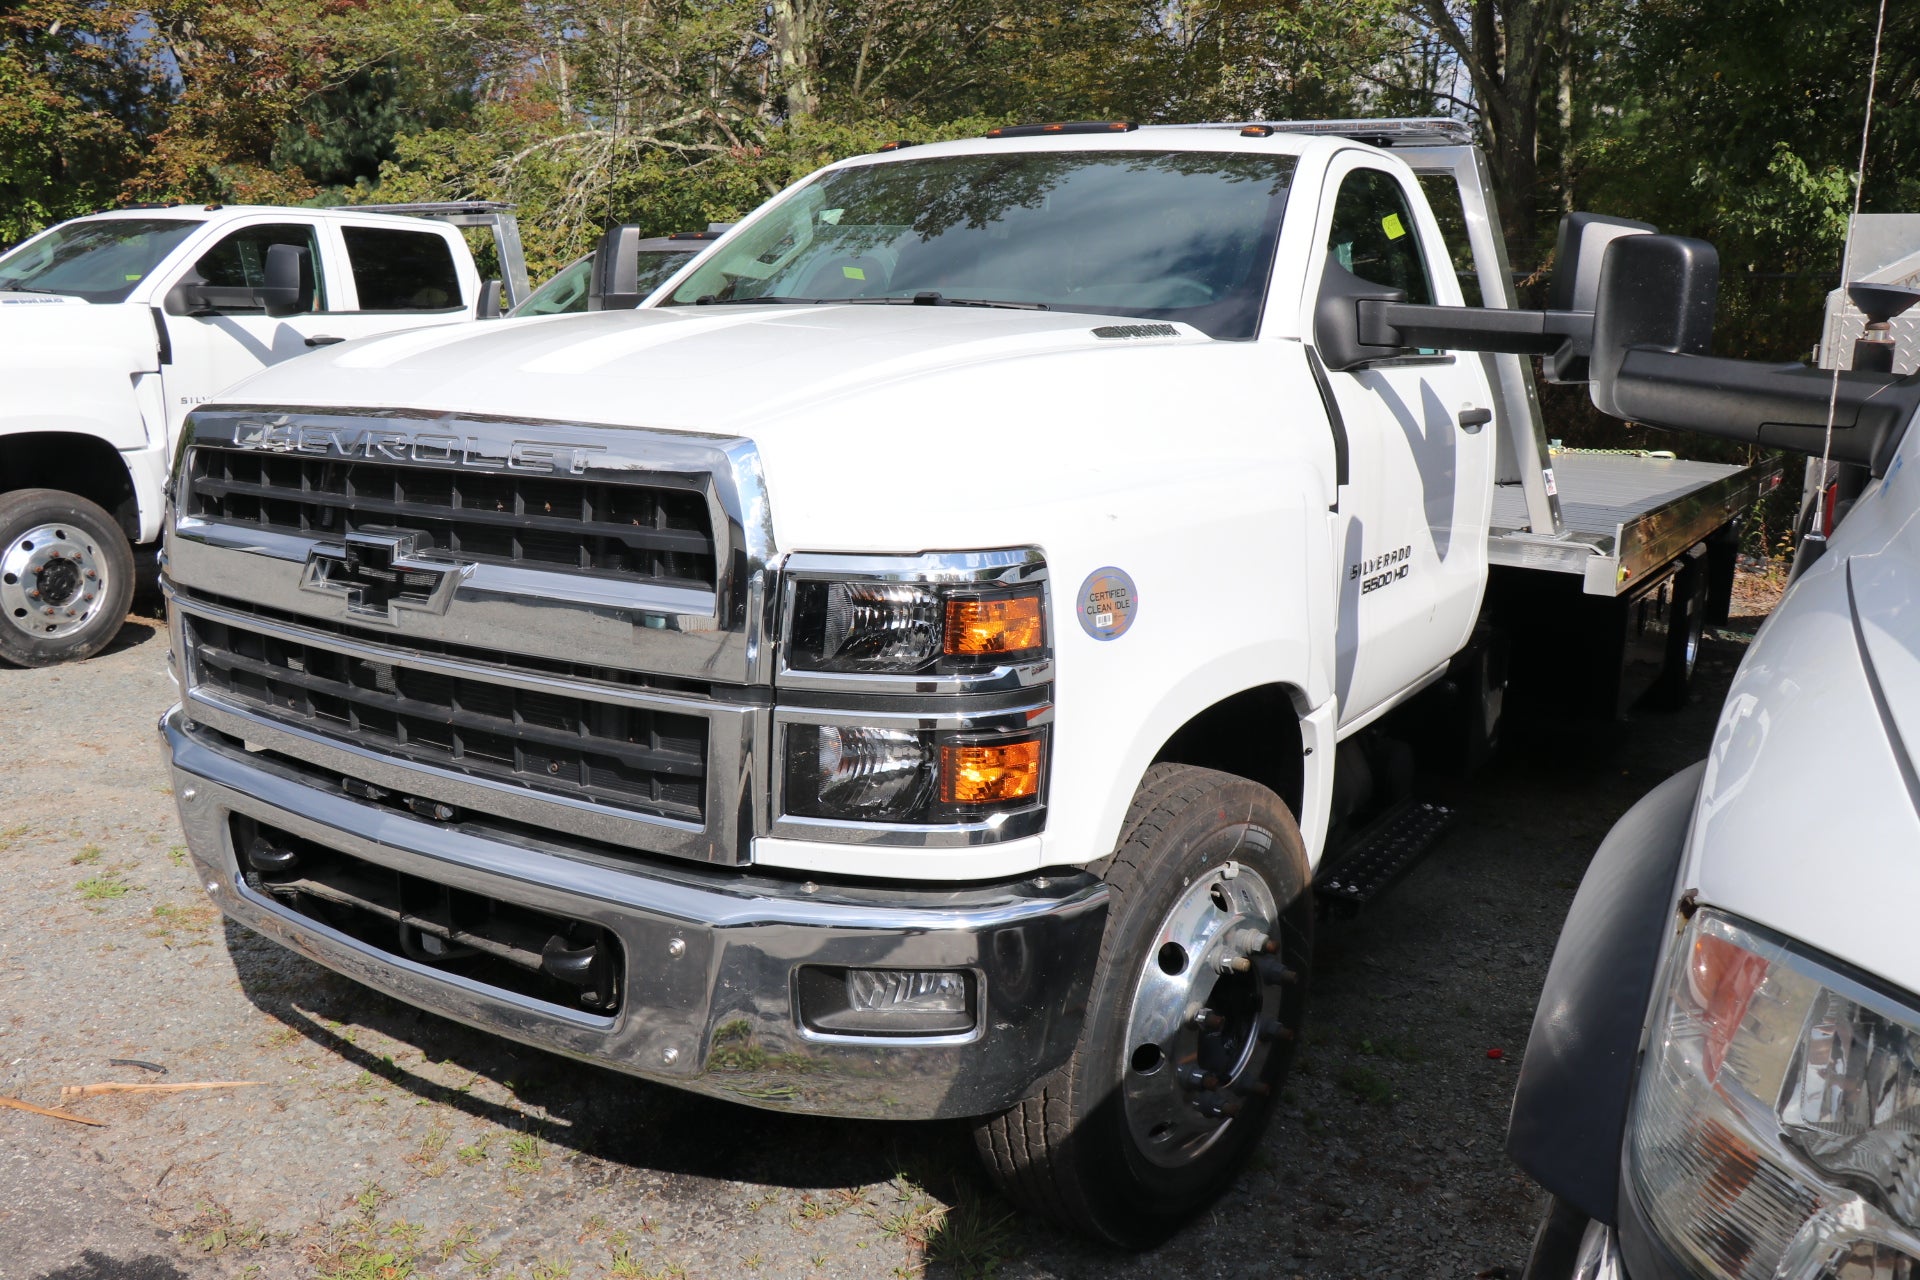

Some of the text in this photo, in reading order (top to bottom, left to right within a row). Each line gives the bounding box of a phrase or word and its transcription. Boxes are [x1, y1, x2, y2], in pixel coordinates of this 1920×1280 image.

[233, 420, 607, 475] CHEVROLET
[1350, 545, 1411, 580] SILVERADO
[1090, 588, 1126, 602] CERTIFIED
[1361, 564, 1409, 595] 5500 HD
[1086, 599, 1130, 615] CLEAN IDLE
